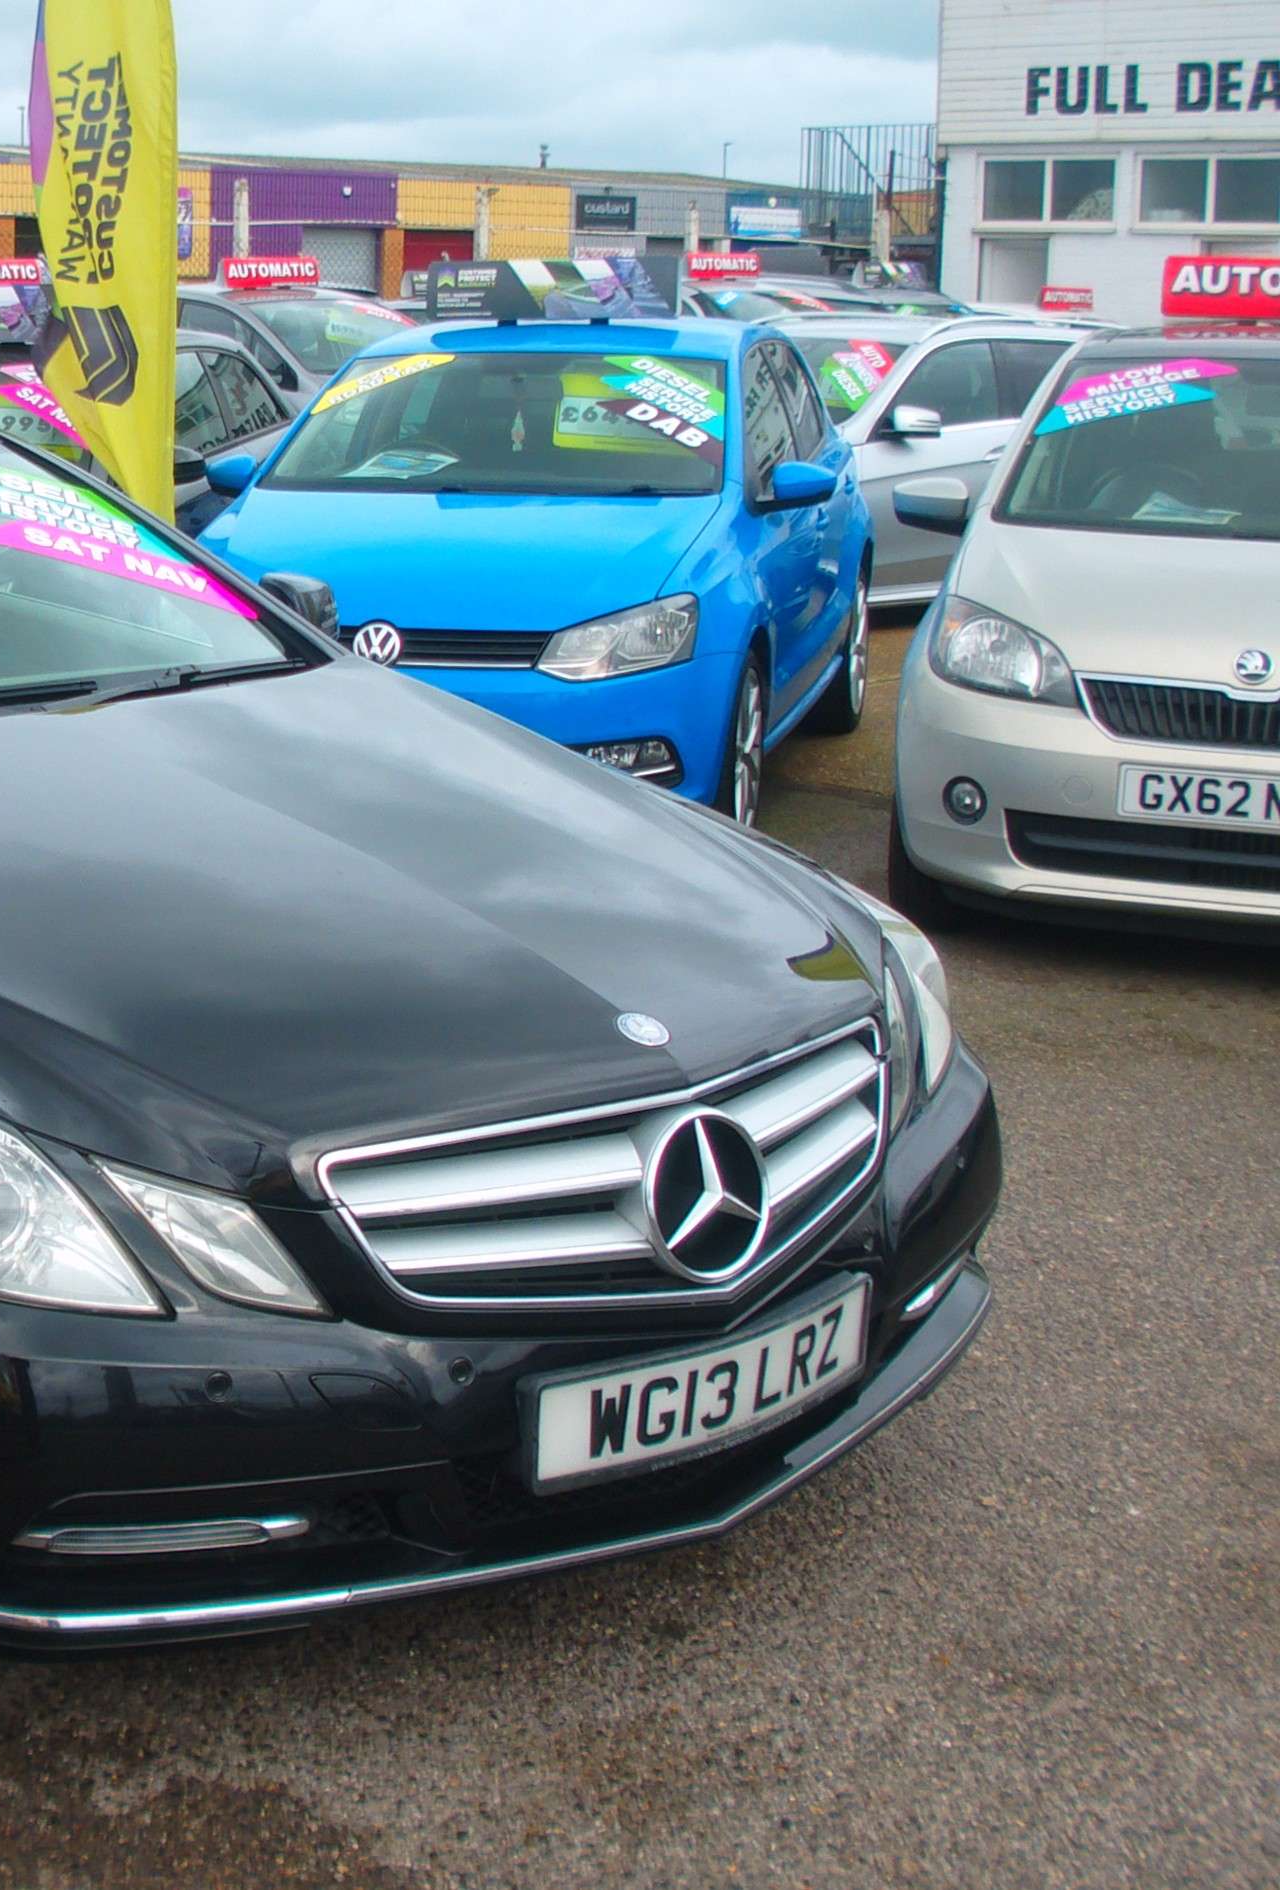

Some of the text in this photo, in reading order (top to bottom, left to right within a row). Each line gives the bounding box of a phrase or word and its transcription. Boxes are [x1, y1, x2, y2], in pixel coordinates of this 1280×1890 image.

[1025, 60, 1280, 116] FULL DEA
[227, 262, 317, 279] AUTOMATIC
[690, 257, 758, 271] AUTOMATIC
[630, 358, 711, 403] DIESEL
[1086, 368, 1201, 398] MILEAGE
[1109, 364, 1164, 383] LOW
[16, 387, 55, 409] SAT
[623, 382, 706, 425] HISTORY
[638, 376, 718, 421] SERVICE
[1062, 383, 1171, 413] SERVICE
[1065, 393, 1177, 425] HISTORY
[625, 402, 710, 449] DAB
[23, 526, 209, 594] SAT NAV
[1139, 773, 1252, 818] GX62
[588, 1360, 739, 1460] WG13
[753, 1304, 844, 1413] LRZ
